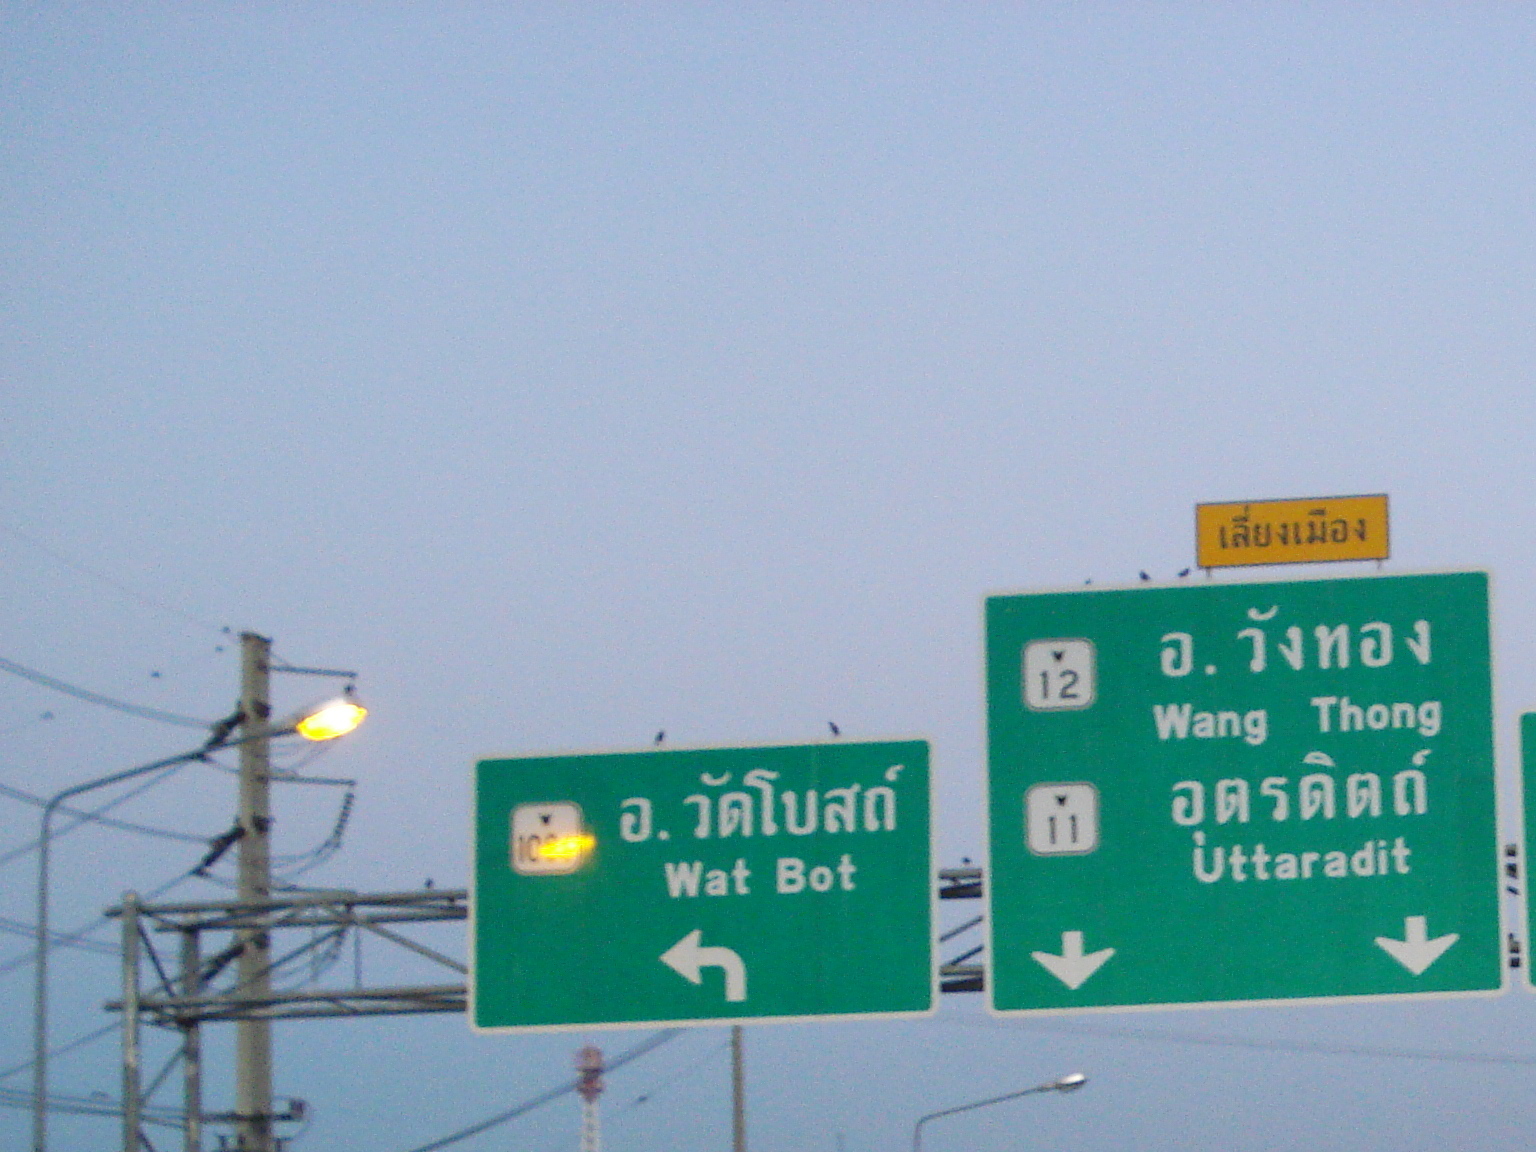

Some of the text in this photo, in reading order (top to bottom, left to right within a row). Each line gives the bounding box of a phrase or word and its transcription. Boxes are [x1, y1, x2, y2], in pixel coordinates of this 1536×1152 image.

[1218, 505, 1367, 549] เลี่ยงเมือง
[1160, 605, 1432, 677] อ. วังทอง
[1039, 668, 1079, 699] 12
[1153, 696, 1442, 746] Wang Thong
[620, 764, 905, 843] อ. วัดโบสถ์
[1171, 749, 1432, 846] อุตรดิตถ์
[1047, 814, 1078, 845] 11
[664, 854, 857, 898] Wat Bot
[1192, 836, 1412, 884] Uttaradit
